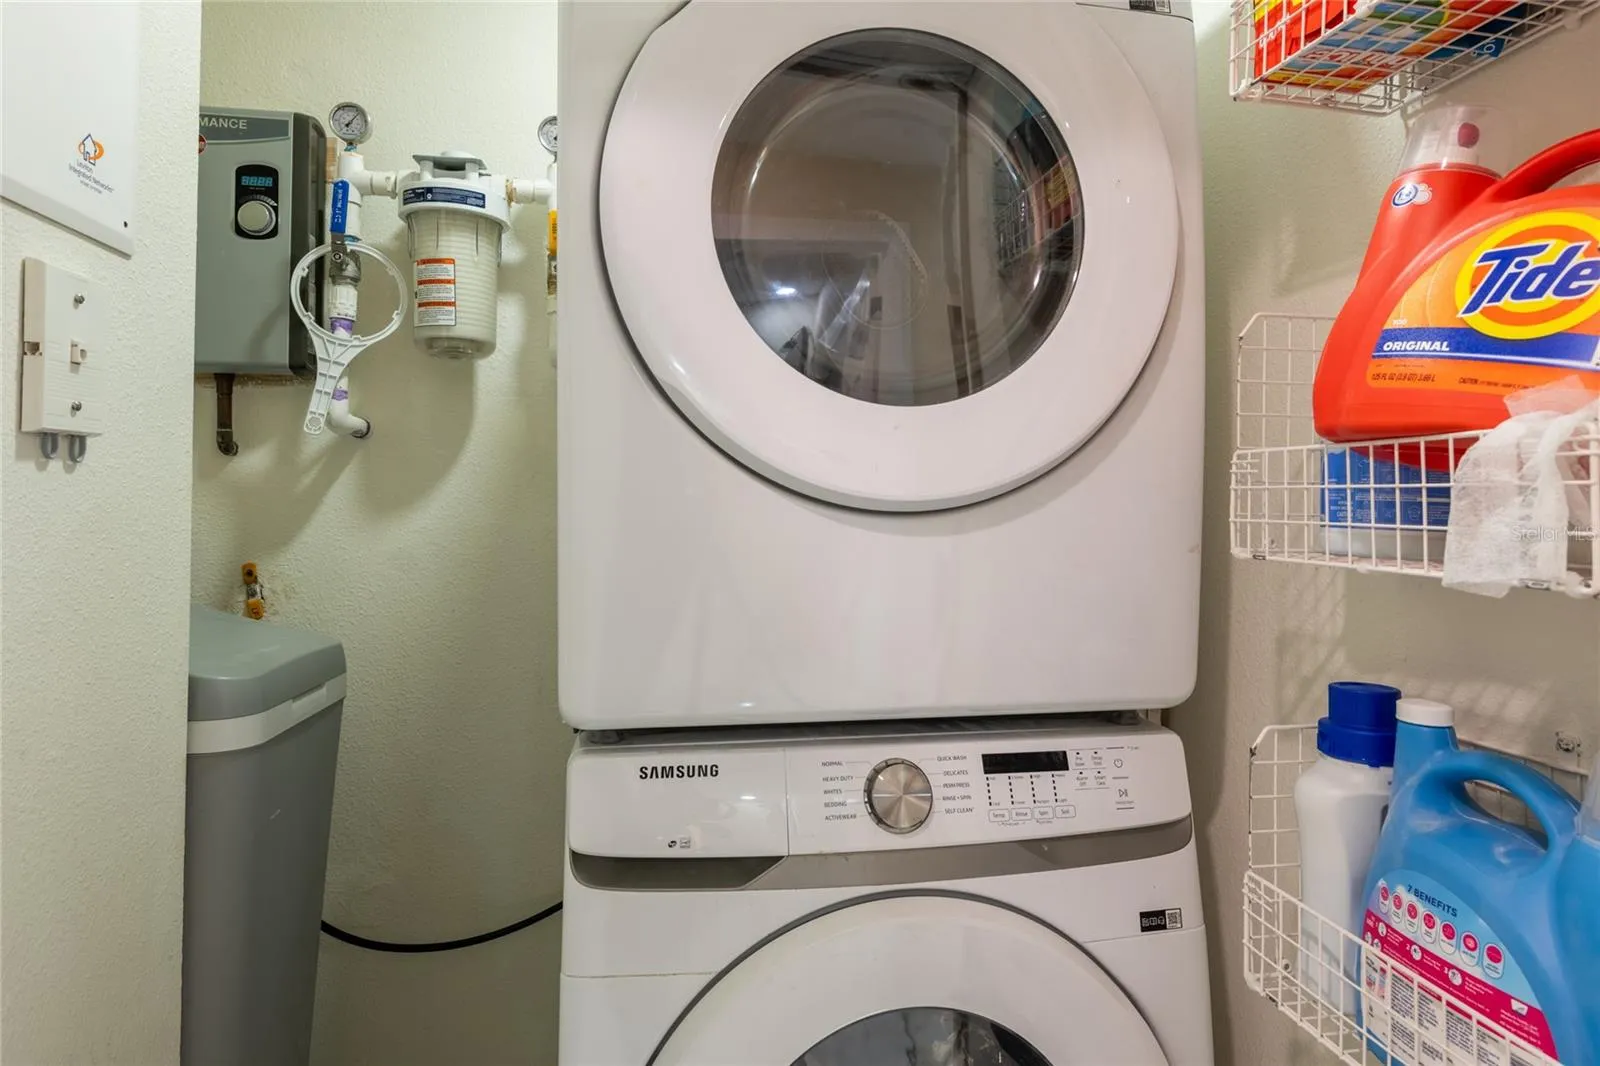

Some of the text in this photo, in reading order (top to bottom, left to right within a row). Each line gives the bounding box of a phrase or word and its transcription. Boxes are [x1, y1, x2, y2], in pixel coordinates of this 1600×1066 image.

[1457, 240, 1600, 318] Tide
[1383, 341, 1450, 352] ORIGINAL
[639, 764, 719, 780] SAMSUNG
[1408, 884, 1413, 893] 7
[1413, 890, 1458, 918] BENEFITS
